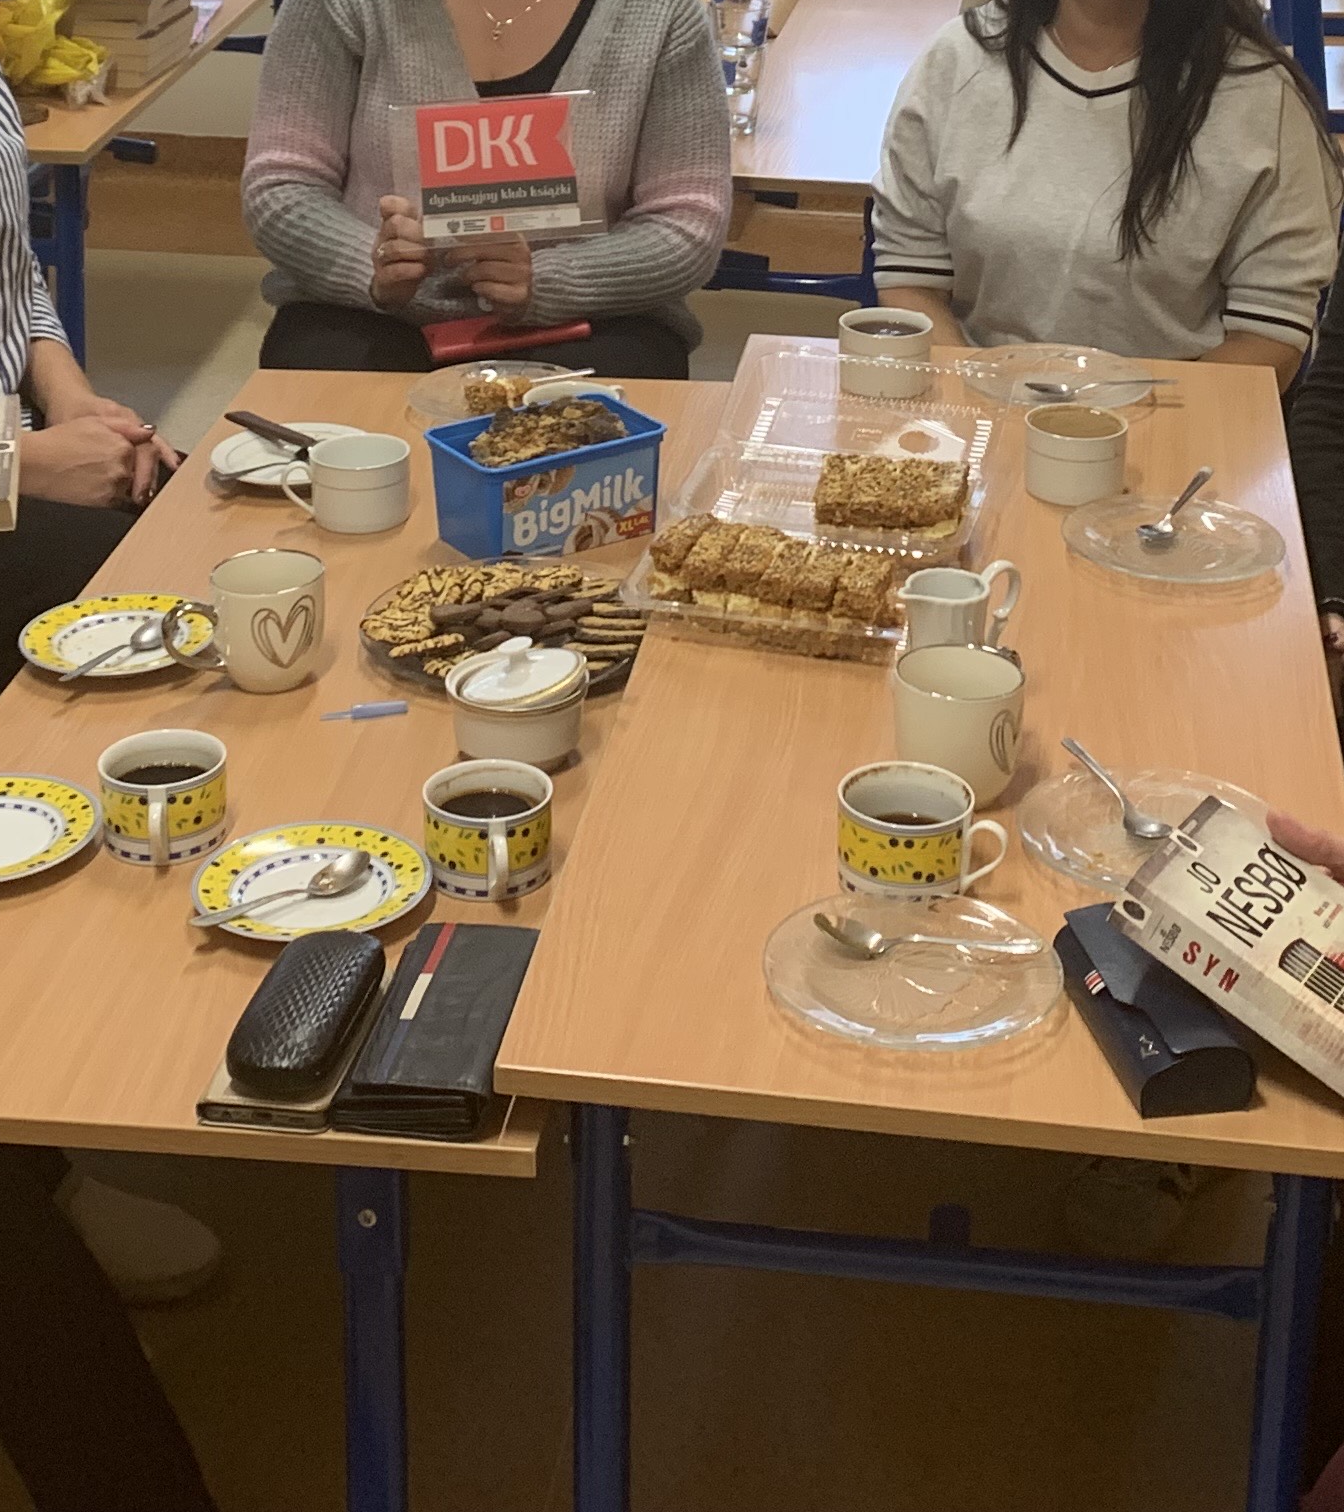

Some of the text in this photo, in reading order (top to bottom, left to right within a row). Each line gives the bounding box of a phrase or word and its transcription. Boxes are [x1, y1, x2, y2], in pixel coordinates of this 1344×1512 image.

[433, 114, 539, 173] DKK
[429, 183, 572, 208] dyskusyjny klub książki
[1186, 861, 1221, 894] JO
[1205, 842, 1308, 949] NESBØ
[1182, 940, 1240, 994] SYN
